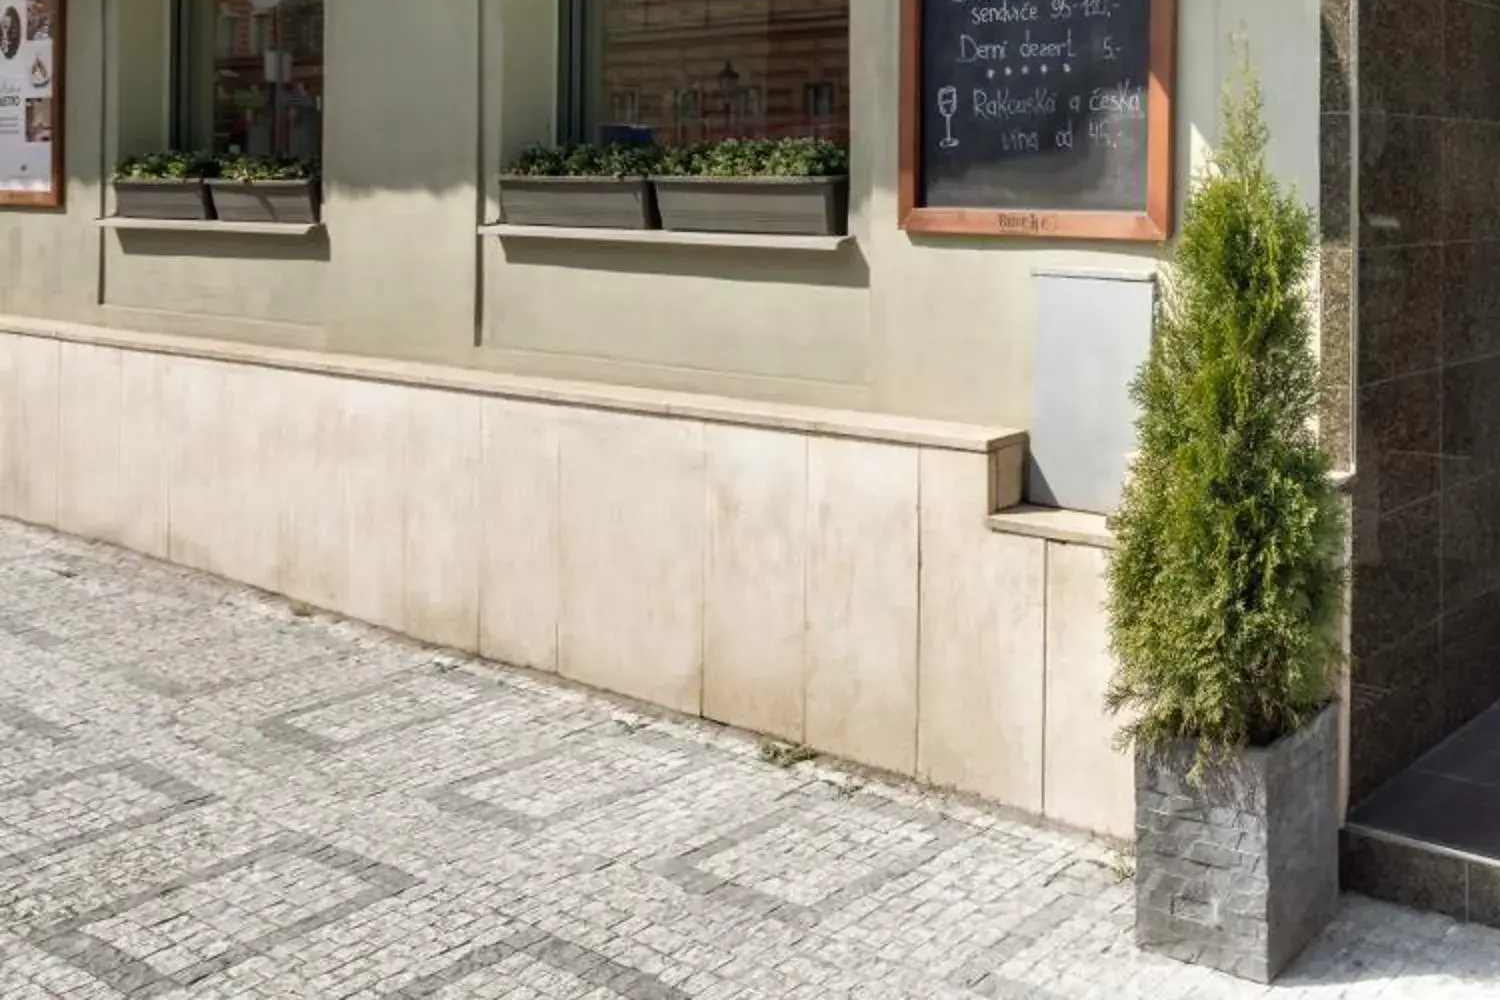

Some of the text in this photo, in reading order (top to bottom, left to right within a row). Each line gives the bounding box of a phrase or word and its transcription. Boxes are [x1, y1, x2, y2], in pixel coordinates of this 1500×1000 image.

[1019, 27, 1077, 59] dezert
[1068, 94, 1081, 113] a
[1055, 119, 1073, 149] od
